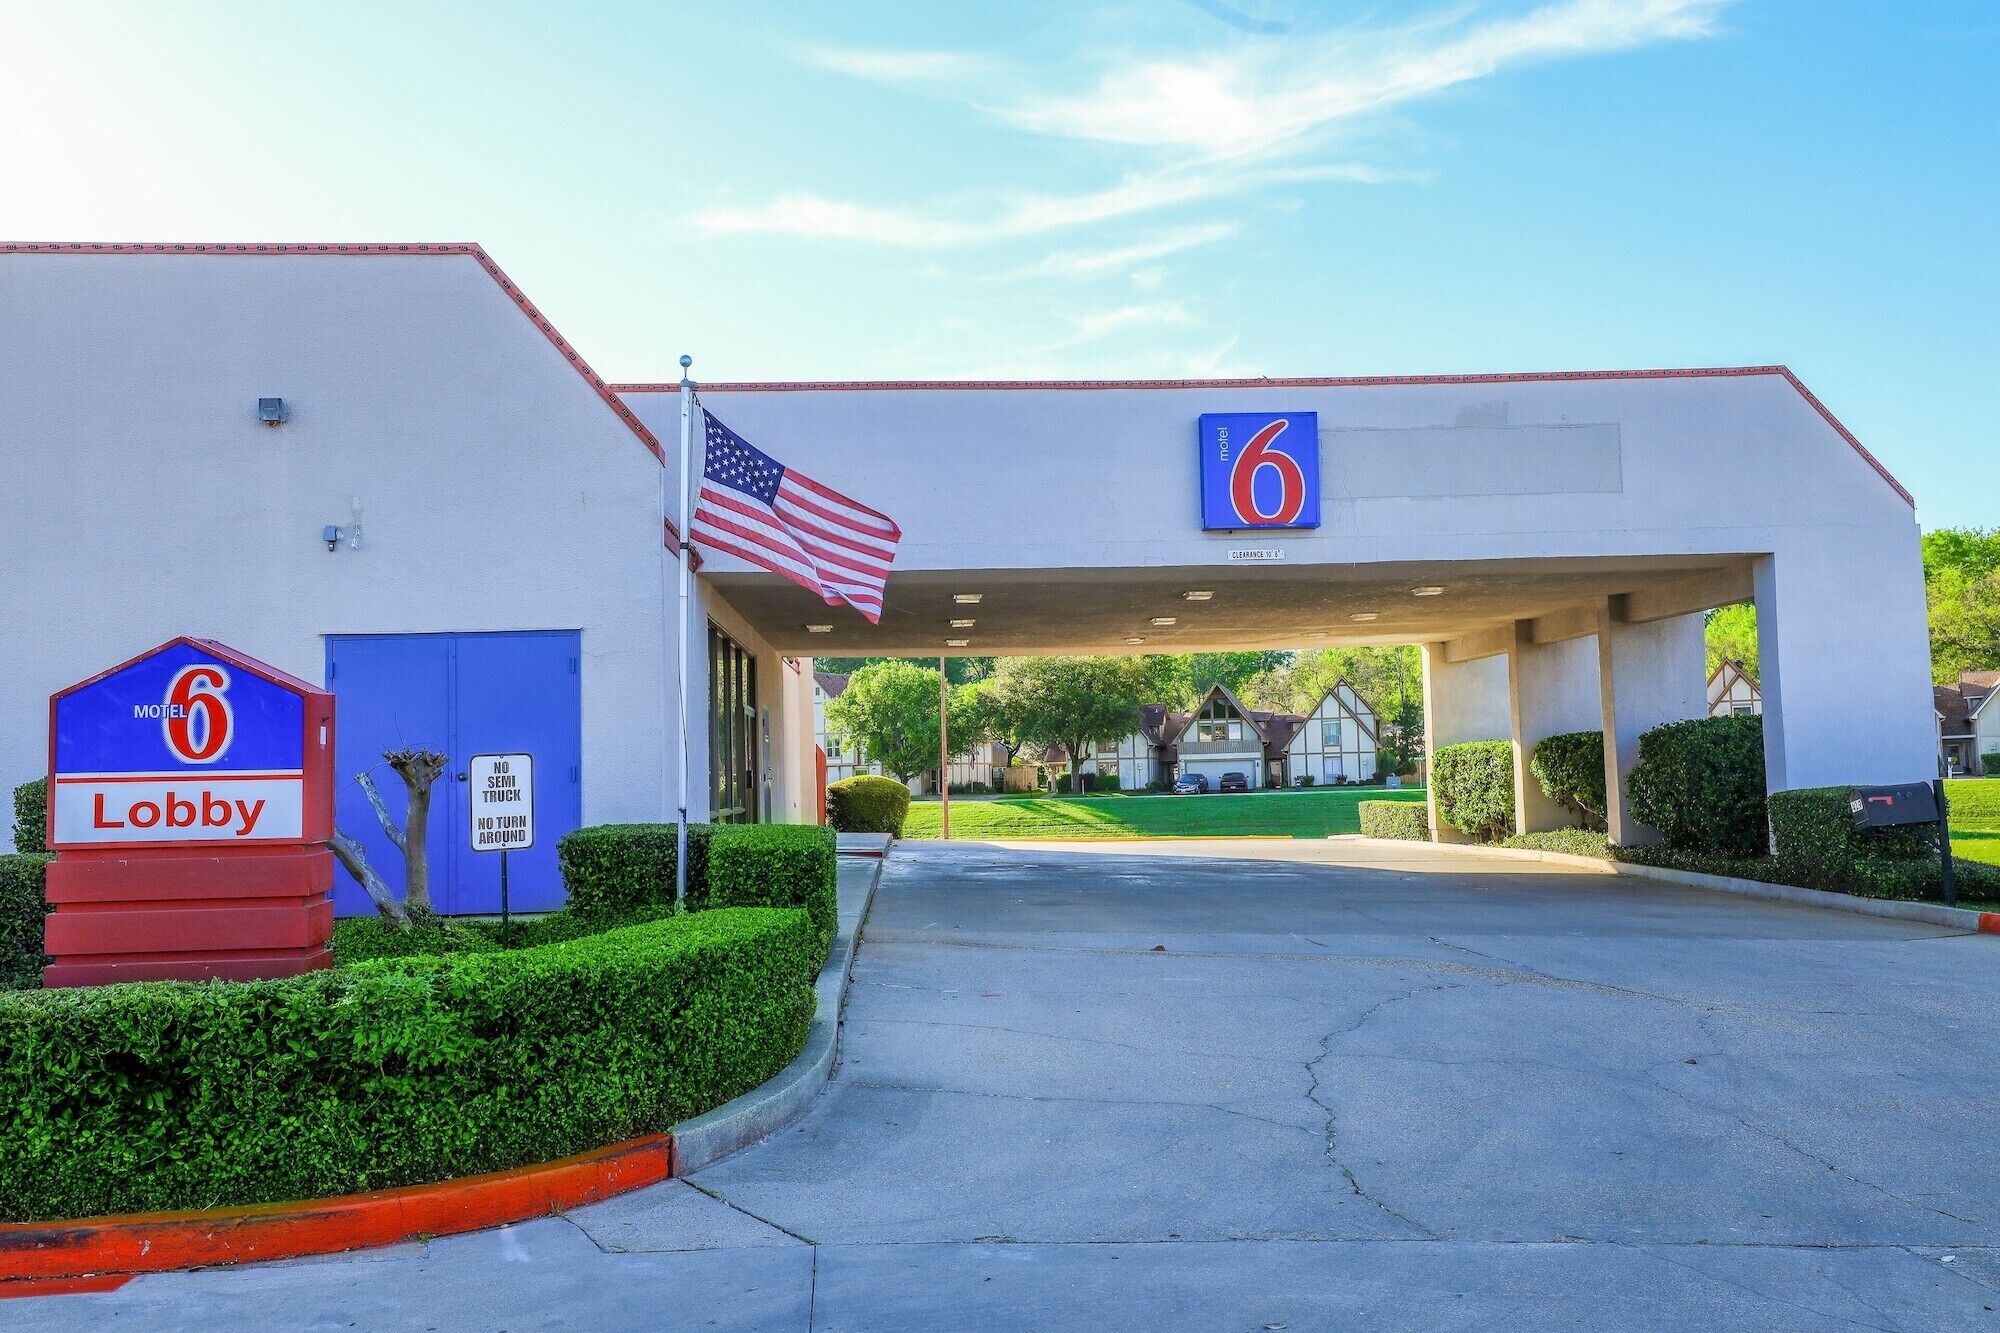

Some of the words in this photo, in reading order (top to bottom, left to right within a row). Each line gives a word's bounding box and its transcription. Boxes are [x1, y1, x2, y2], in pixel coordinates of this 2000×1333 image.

[1216, 427, 1229, 461] motel
[1230, 418, 1306, 525] 6
[1232, 550, 1264, 559] CLEARANCE
[133, 704, 188, 719] MOTEL
[163, 665, 234, 763] 6
[494, 761, 509, 774] NO
[488, 776, 516, 788] SEMI
[482, 789, 521, 803] TRUCK
[93, 791, 266, 836] Lobby
[478, 817, 493, 830] NO
[496, 815, 527, 829] TURN
[479, 830, 526, 844] AROUND
